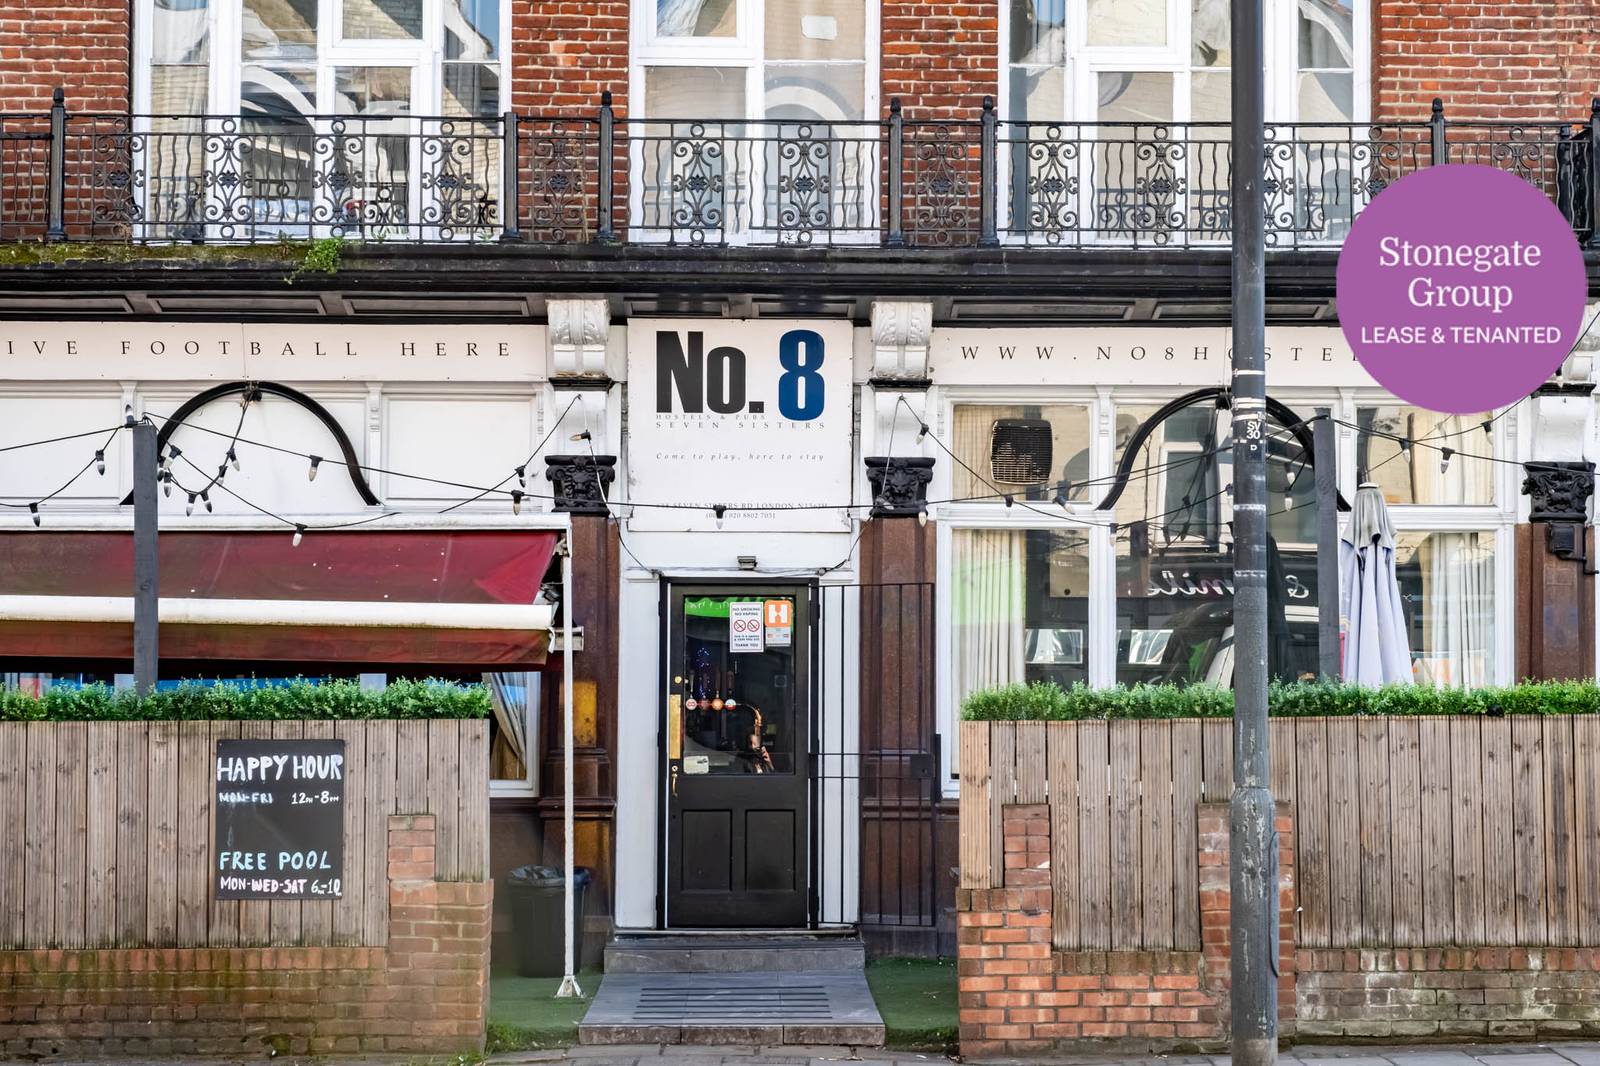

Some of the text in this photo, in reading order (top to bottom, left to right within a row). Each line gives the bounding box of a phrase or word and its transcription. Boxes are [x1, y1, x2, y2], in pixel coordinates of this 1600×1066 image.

[120, 340, 357, 356] FOOTBALL
[401, 342, 510, 357] HERE
[960, 346, 1360, 361] WWW.NO8HSTE
[656, 329, 825, 421] No. 8
[655, 421, 825, 429] SEVEN SISTERS
[1246, 430, 1261, 439] 30
[656, 452, 685, 460] Come
[692, 452, 704, 460] to
[749, 452, 774, 460] here
[781, 452, 793, 460] to
[768, 604, 788, 623] H
[216, 754, 344, 782] HAPPY HOUR
[219, 850, 331, 871] FREE POOL
[220, 876, 307, 894] MON-WED-SAT
